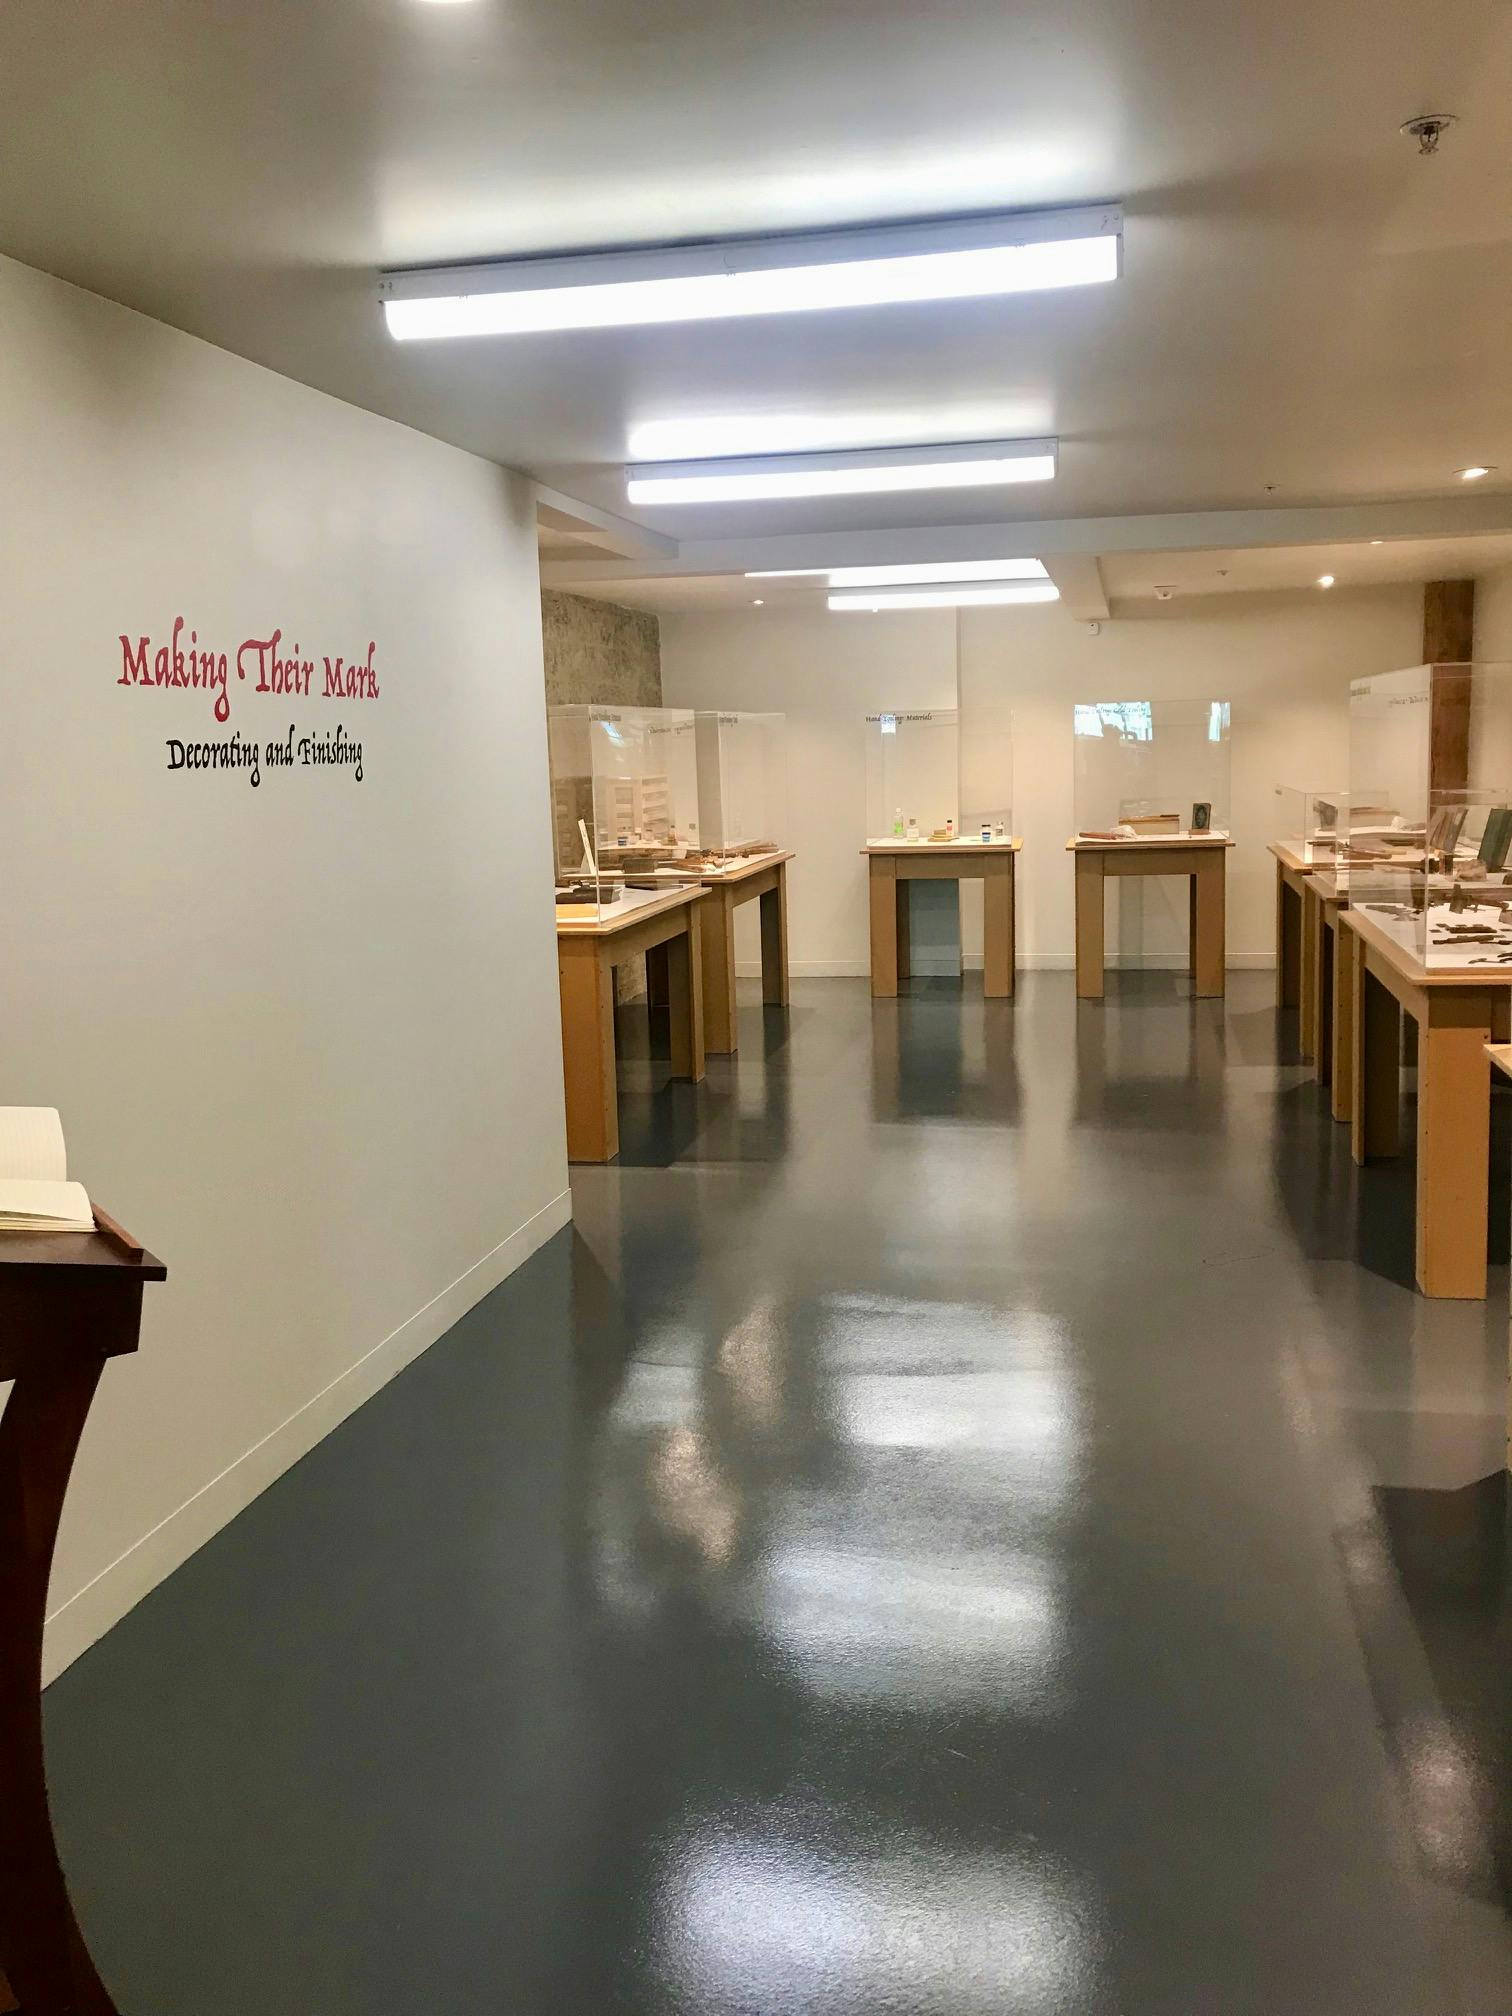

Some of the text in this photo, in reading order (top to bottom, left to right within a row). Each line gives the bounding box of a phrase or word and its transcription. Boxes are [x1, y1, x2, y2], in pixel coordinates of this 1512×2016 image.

[116, 616, 380, 722] Making Their Mark
[166, 724, 363, 787] Decorating and Finishing
